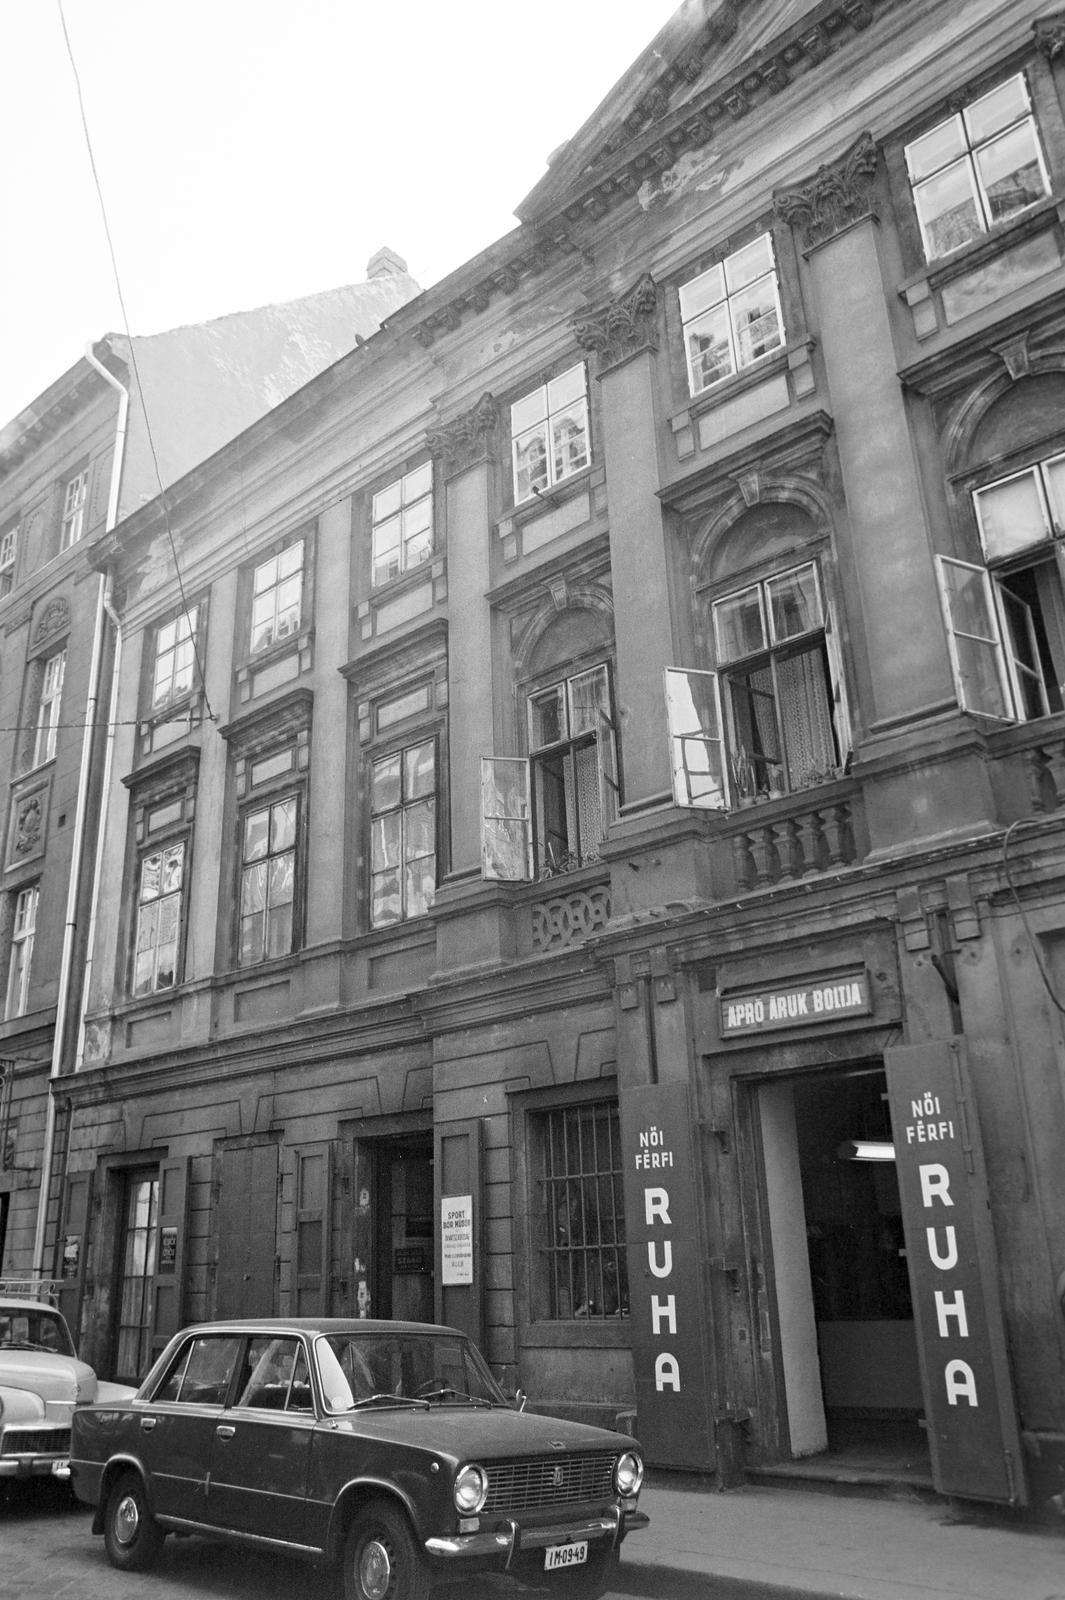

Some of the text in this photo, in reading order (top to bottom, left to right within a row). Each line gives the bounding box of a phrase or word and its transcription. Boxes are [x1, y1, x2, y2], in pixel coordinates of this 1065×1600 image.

[447, 1210, 465, 1220] SPORT
[644, 1187, 681, 1392] RUHA
[909, 1163, 979, 1407] RUHA
